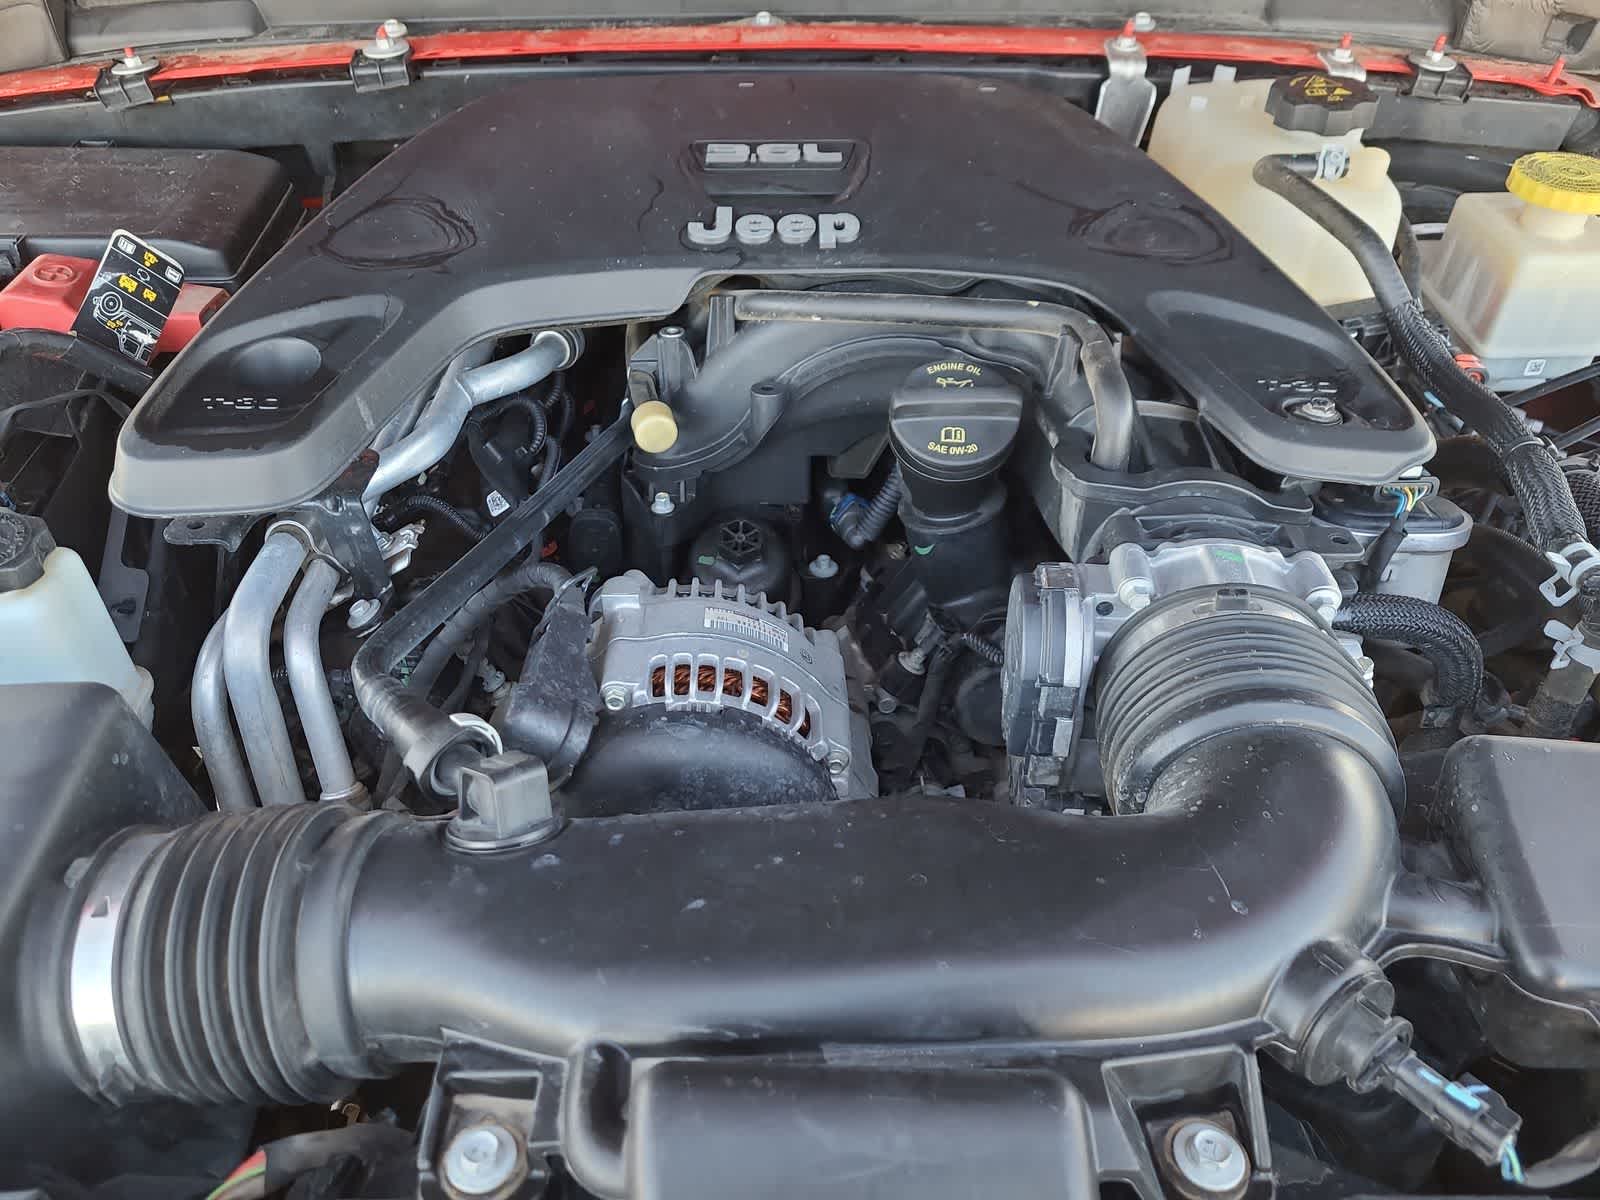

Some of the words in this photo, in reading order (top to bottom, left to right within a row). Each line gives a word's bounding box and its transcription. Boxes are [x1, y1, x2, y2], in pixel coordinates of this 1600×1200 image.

[687, 206, 861, 249] Jeep
[926, 362, 965, 375] ENGINE
[966, 364, 982, 376] OIL
[927, 441, 948, 455] SAE
[949, 443, 978, 455] 0W-20
